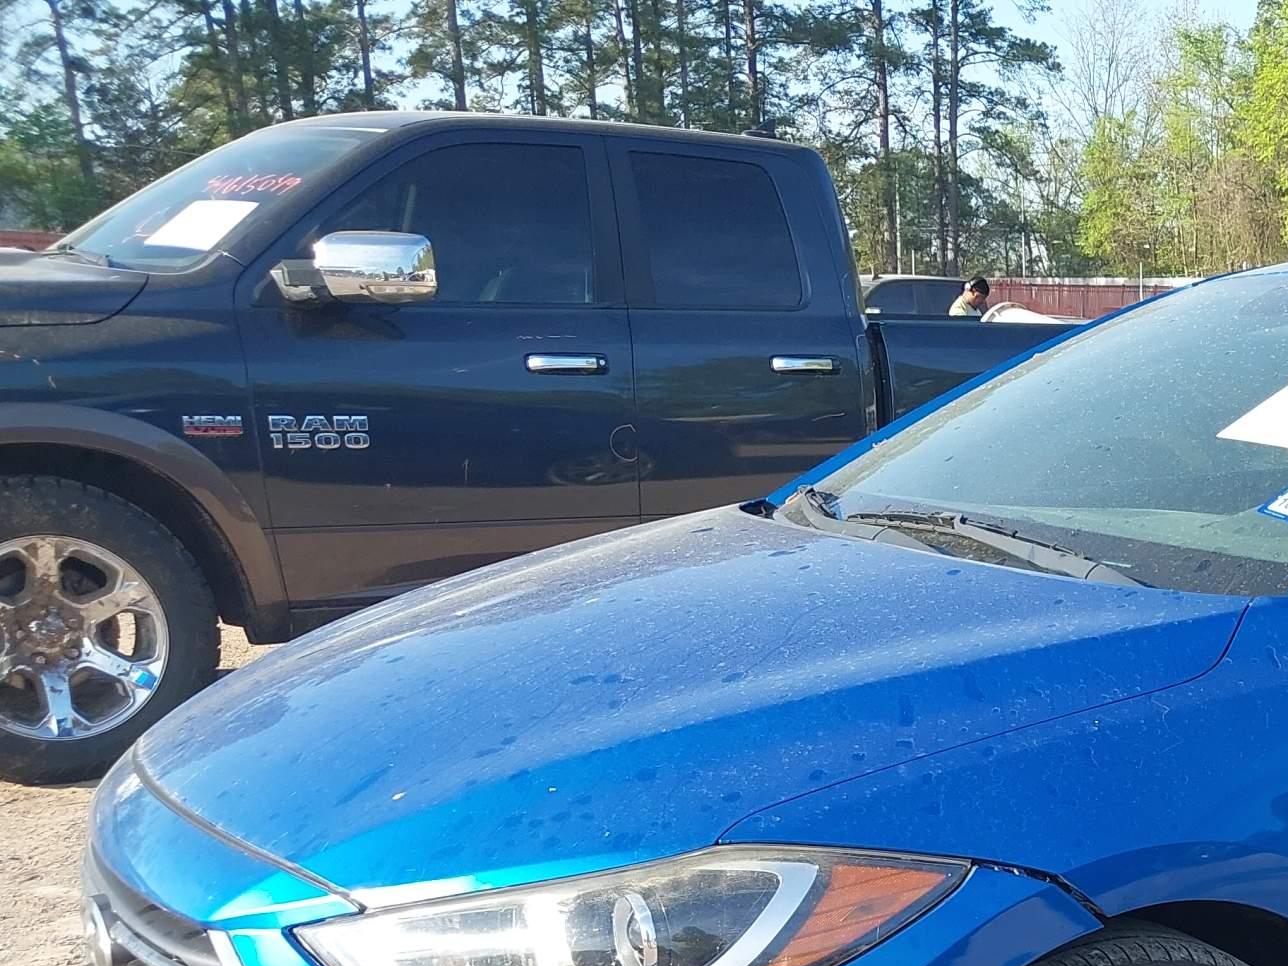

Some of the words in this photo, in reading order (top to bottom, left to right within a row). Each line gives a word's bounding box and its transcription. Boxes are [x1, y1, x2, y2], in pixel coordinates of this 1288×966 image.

[182, 415, 242, 427] HEMI
[268, 415, 369, 431] RAM
[270, 432, 370, 449] 1500
